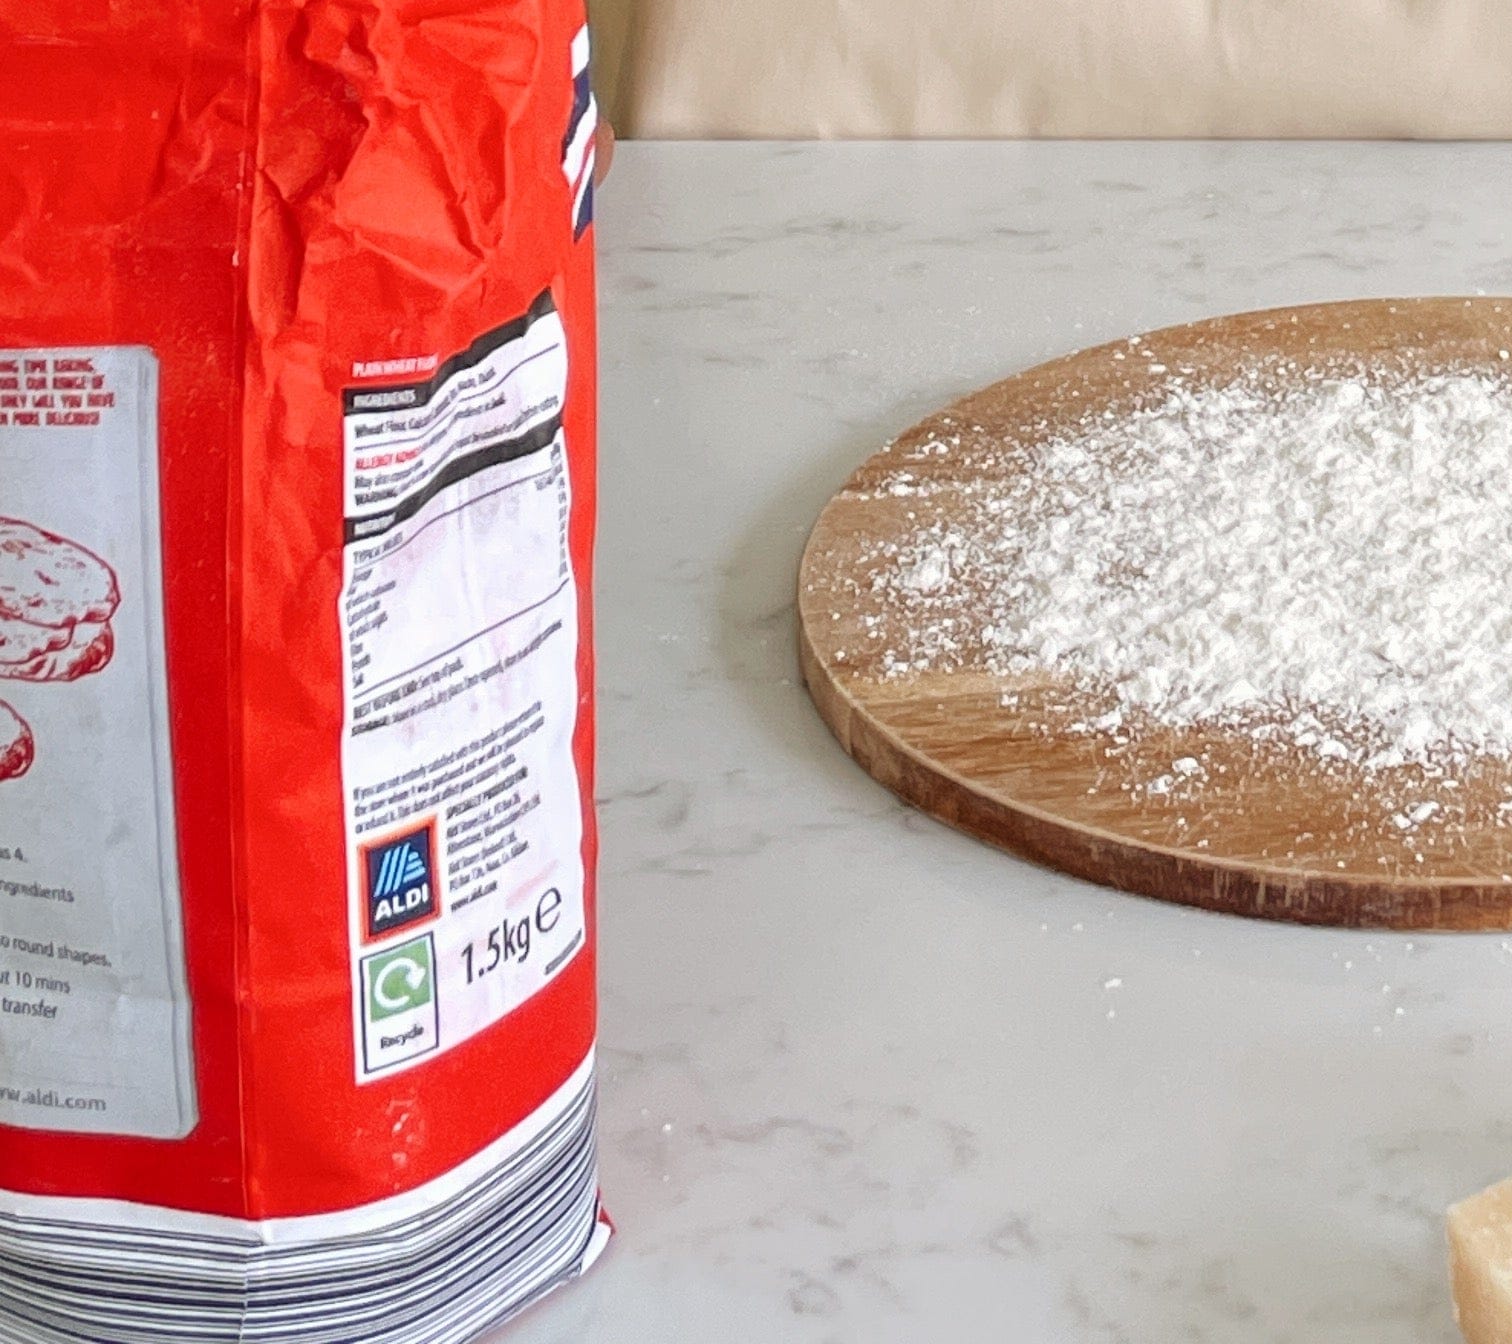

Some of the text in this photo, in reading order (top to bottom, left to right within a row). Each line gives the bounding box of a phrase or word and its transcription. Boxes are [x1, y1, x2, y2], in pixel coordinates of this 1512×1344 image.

[0, 878, 75, 903] ngredients
[374, 883, 429, 922] ALDI
[12, 937, 54, 958] round
[460, 914, 531, 986] 1.5kg
[15, 970, 32, 989] 10
[35, 976, 71, 995] mins
[1, 996, 58, 1019] transfer
[380, 1021, 425, 1050] Recycle
[0, 1086, 108, 1112] w.aldi.com
